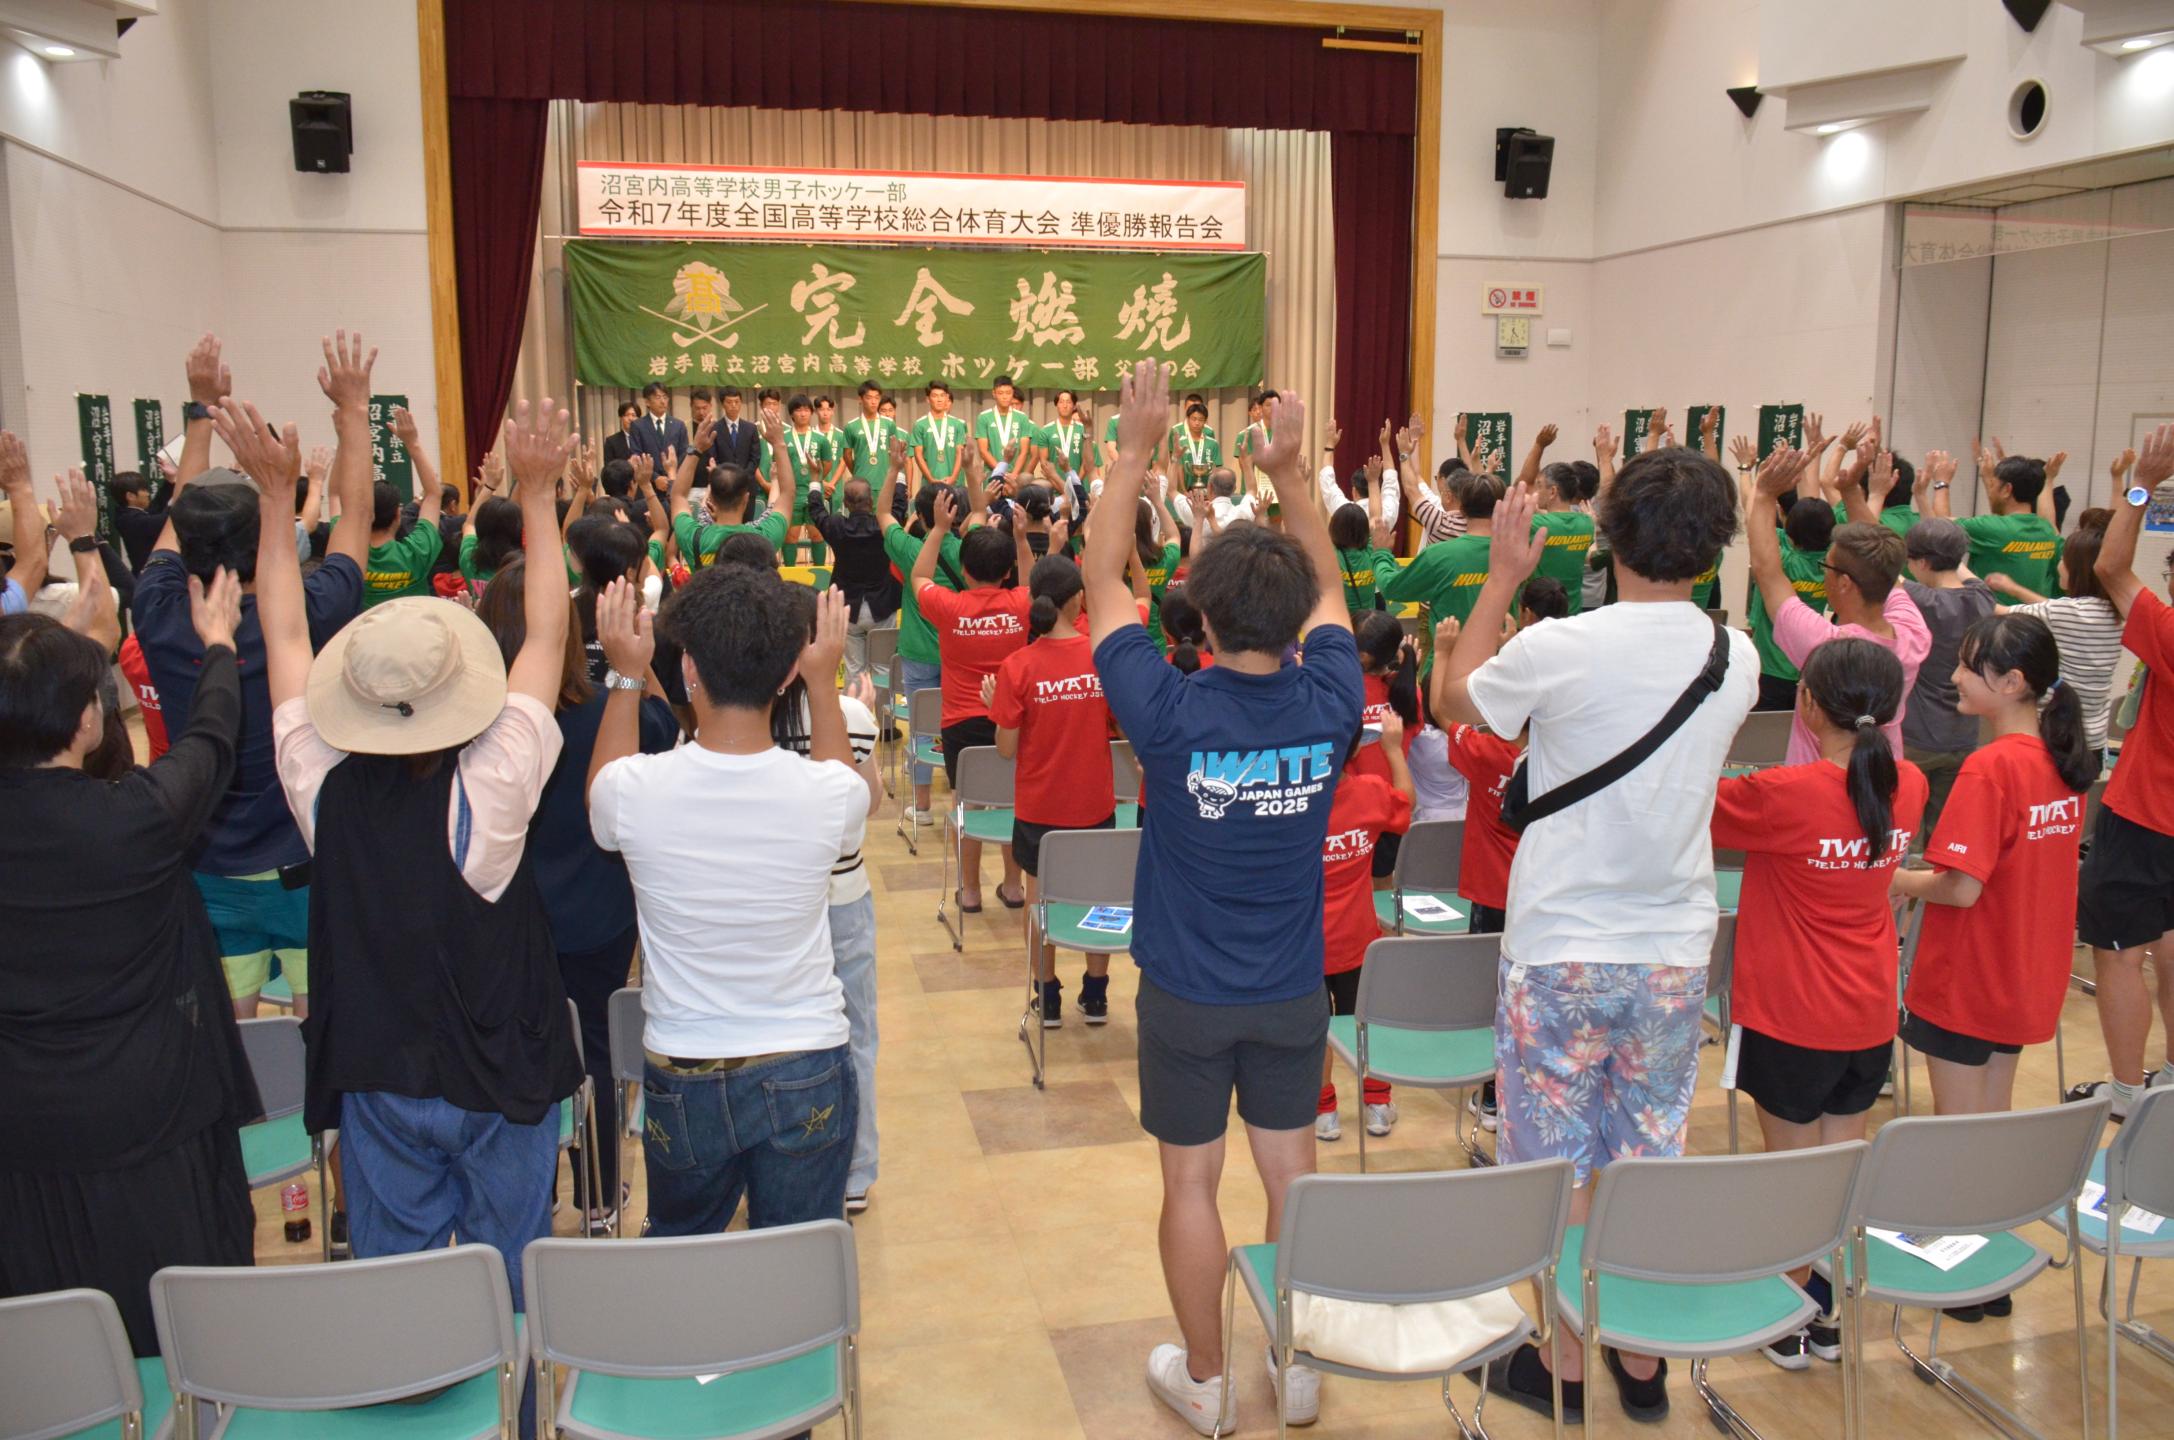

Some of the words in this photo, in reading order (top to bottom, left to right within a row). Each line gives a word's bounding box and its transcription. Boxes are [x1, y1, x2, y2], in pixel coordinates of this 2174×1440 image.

[600, 173, 907, 204] 沼宮内高等学校男子ホッケー部
[598, 198, 1061, 236] 令和7年度全国高等学校総合体育大会
[1070, 210, 1224, 240] 準優勝報告会
[648, 353, 924, 377] 岩手県立沼宮内高等学校
[1115, 358, 1200, 378] 父の会
[958, 613, 1021, 629] IWATE
[1036, 673, 1103, 696] IWATE
[1189, 741, 1335, 787] IWATE
[1238, 788, 1283, 801] JAPAN
[1284, 782, 1324, 798] GAMES
[1254, 797, 1309, 816] 2025
